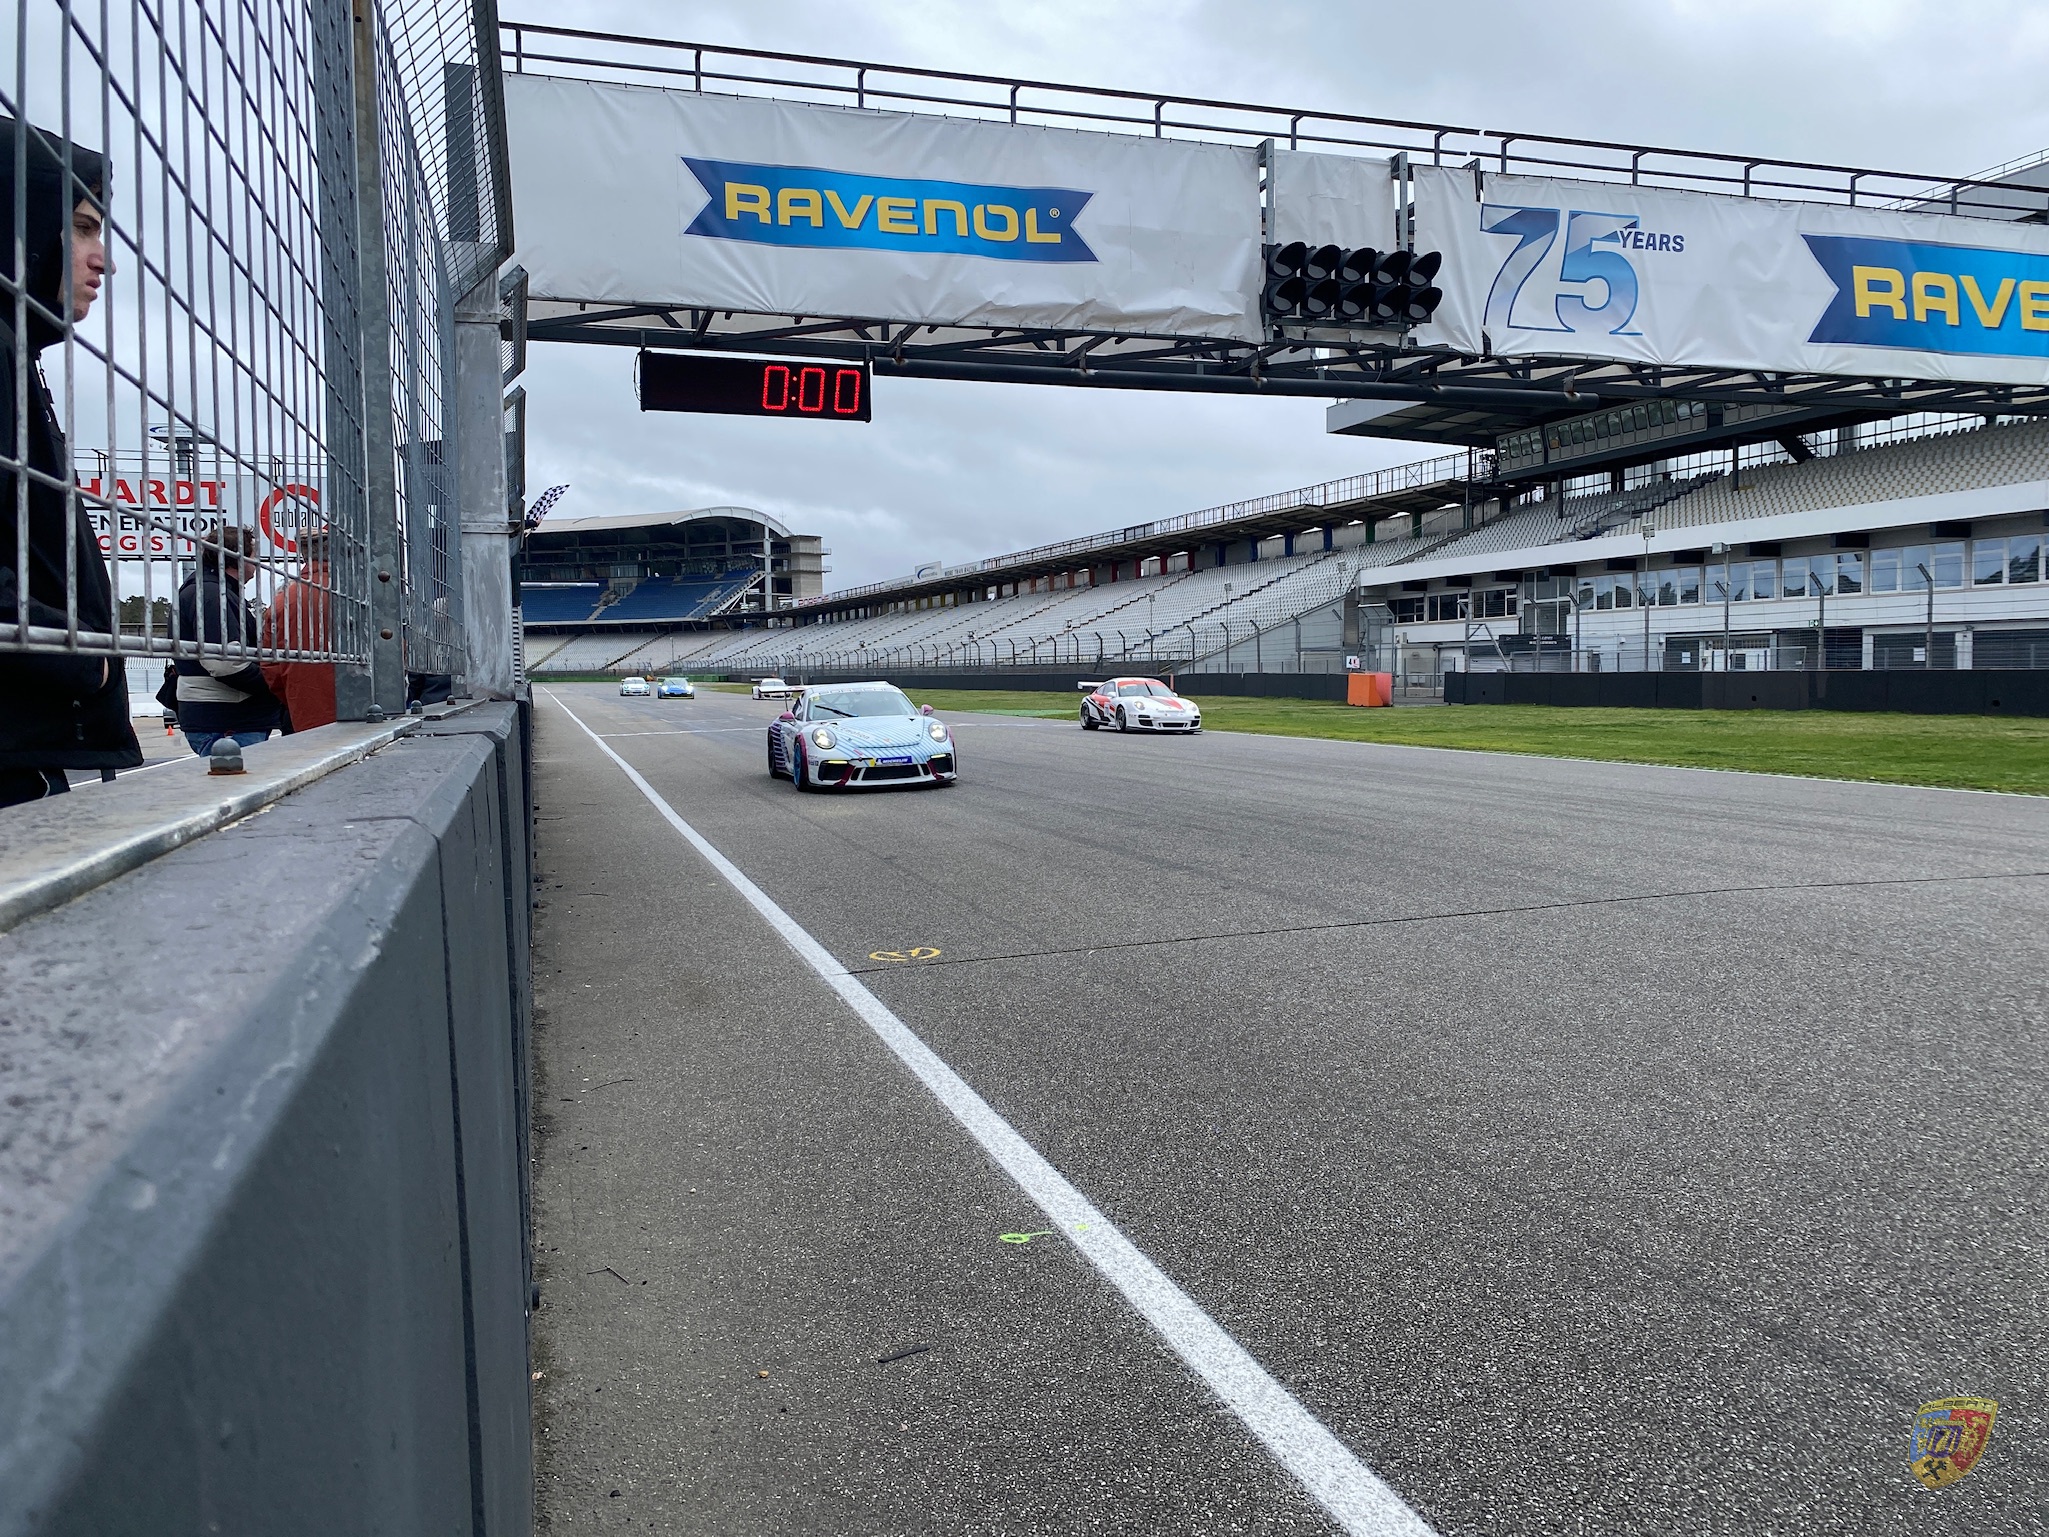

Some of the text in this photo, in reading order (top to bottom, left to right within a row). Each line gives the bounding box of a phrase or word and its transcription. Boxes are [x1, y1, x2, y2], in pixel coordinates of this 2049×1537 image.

[1480, 203, 1685, 336] 75 YEARS
[1852, 265, 2049, 332] RAVE
[762, 365, 861, 413] 0:00
